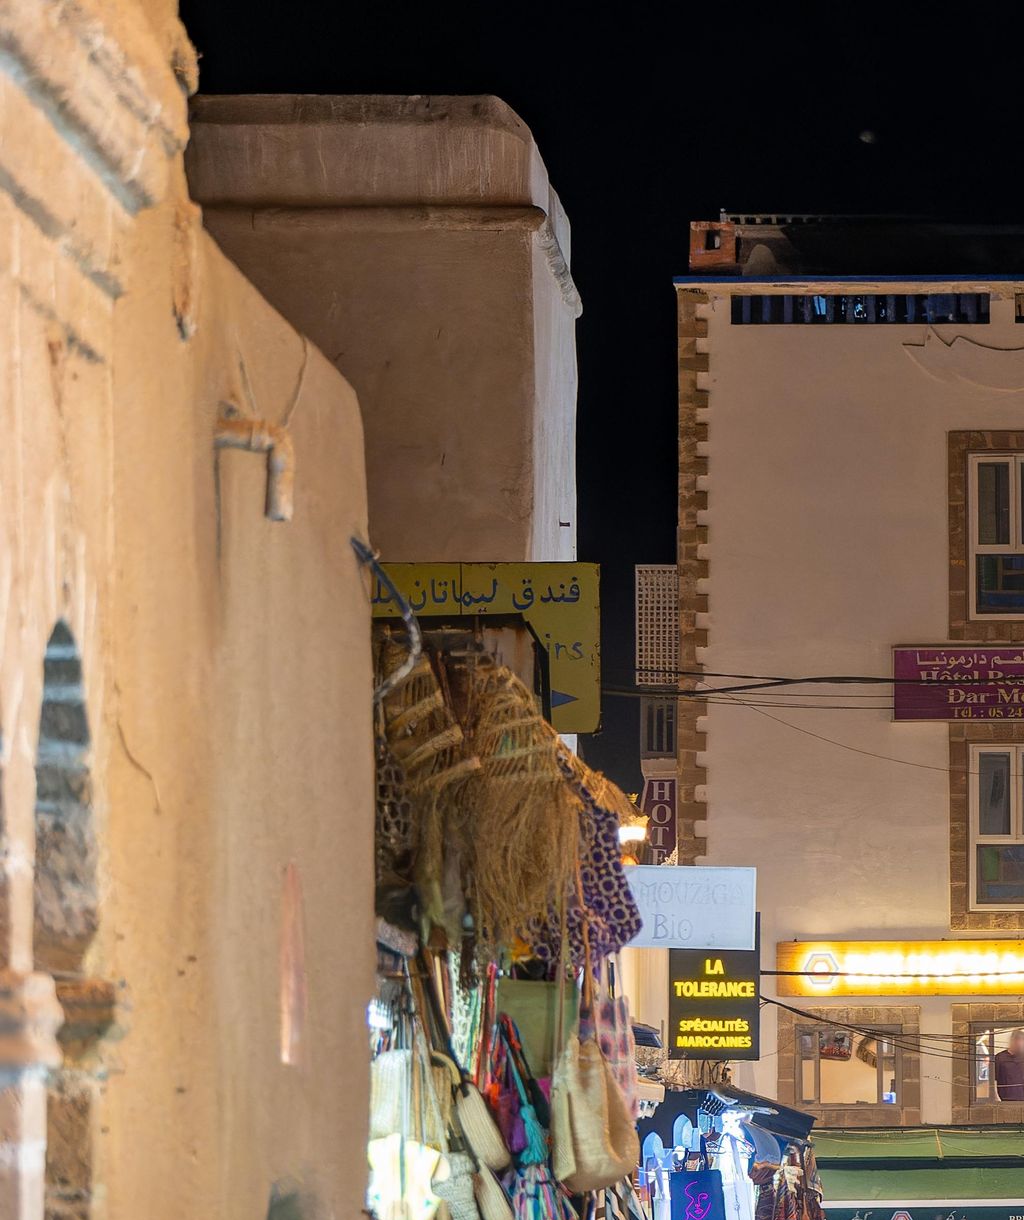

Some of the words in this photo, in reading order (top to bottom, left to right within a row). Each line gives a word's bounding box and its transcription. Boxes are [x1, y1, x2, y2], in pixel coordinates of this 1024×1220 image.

[947, 688, 988, 704] Dar
[705, 959, 724, 974] LA
[674, 982, 755, 997] TOLERANCE
[679, 1018, 749, 1031] SPÉCIALITÉS
[676, 1036, 752, 1048] MAROCAINES
